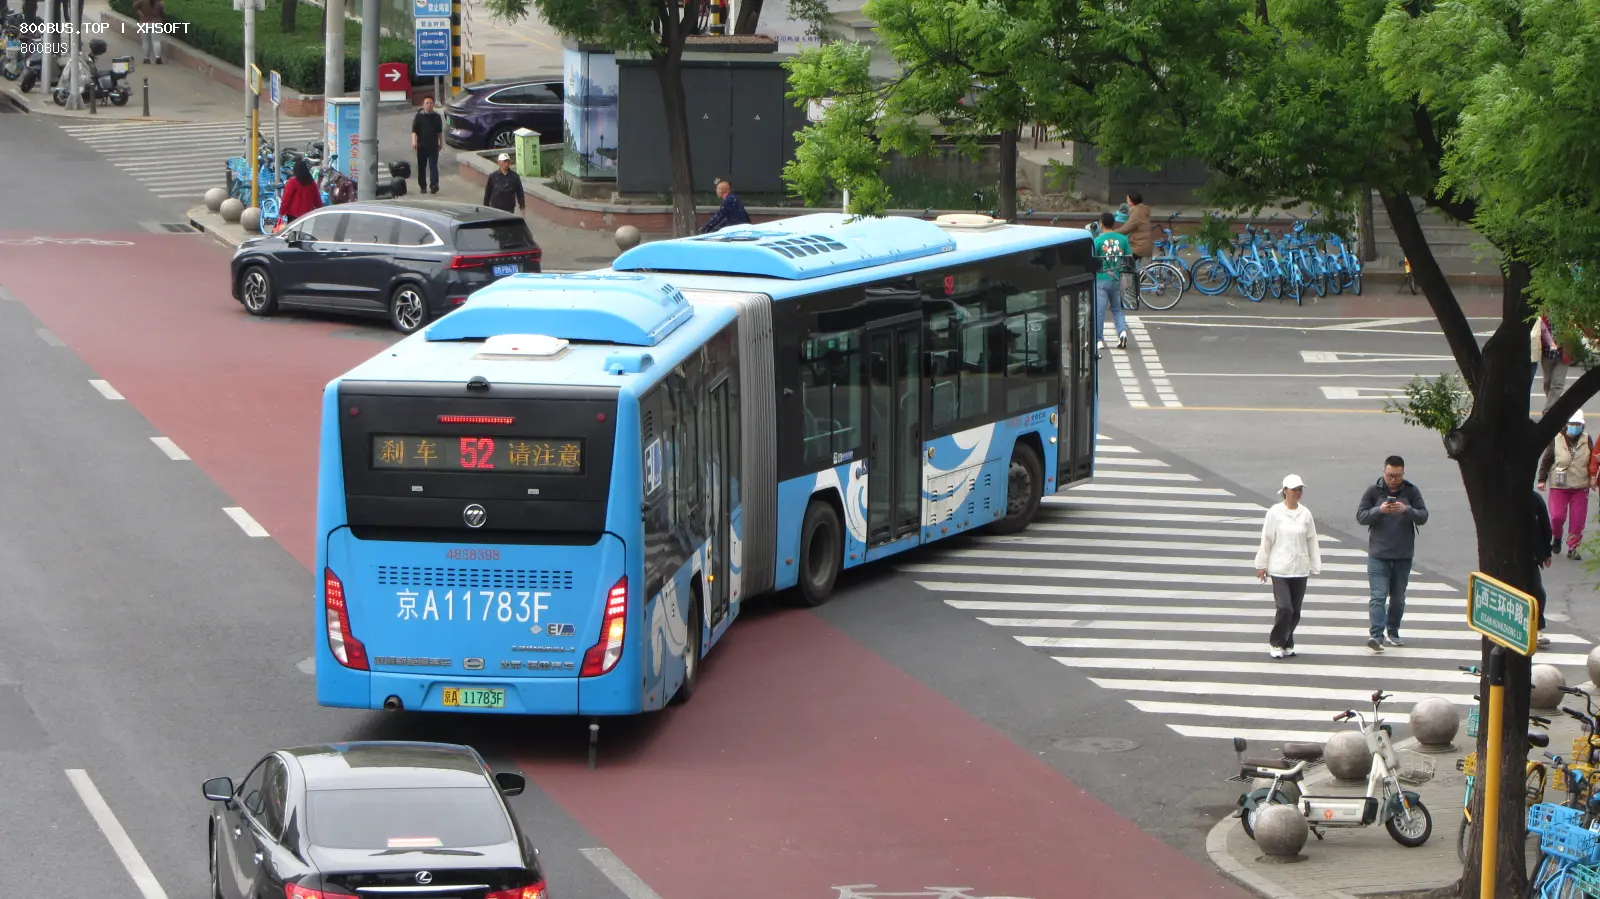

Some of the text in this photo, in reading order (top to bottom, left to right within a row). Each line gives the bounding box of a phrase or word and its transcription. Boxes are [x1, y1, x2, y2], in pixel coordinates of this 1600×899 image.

[460, 437, 495, 469] 52
[508, 442, 581, 467] 请注意
[396, 588, 552, 623] 京A11783F
[1481, 586, 1524, 625] 西三环中路
[445, 691, 503, 704] 京A 11783F
